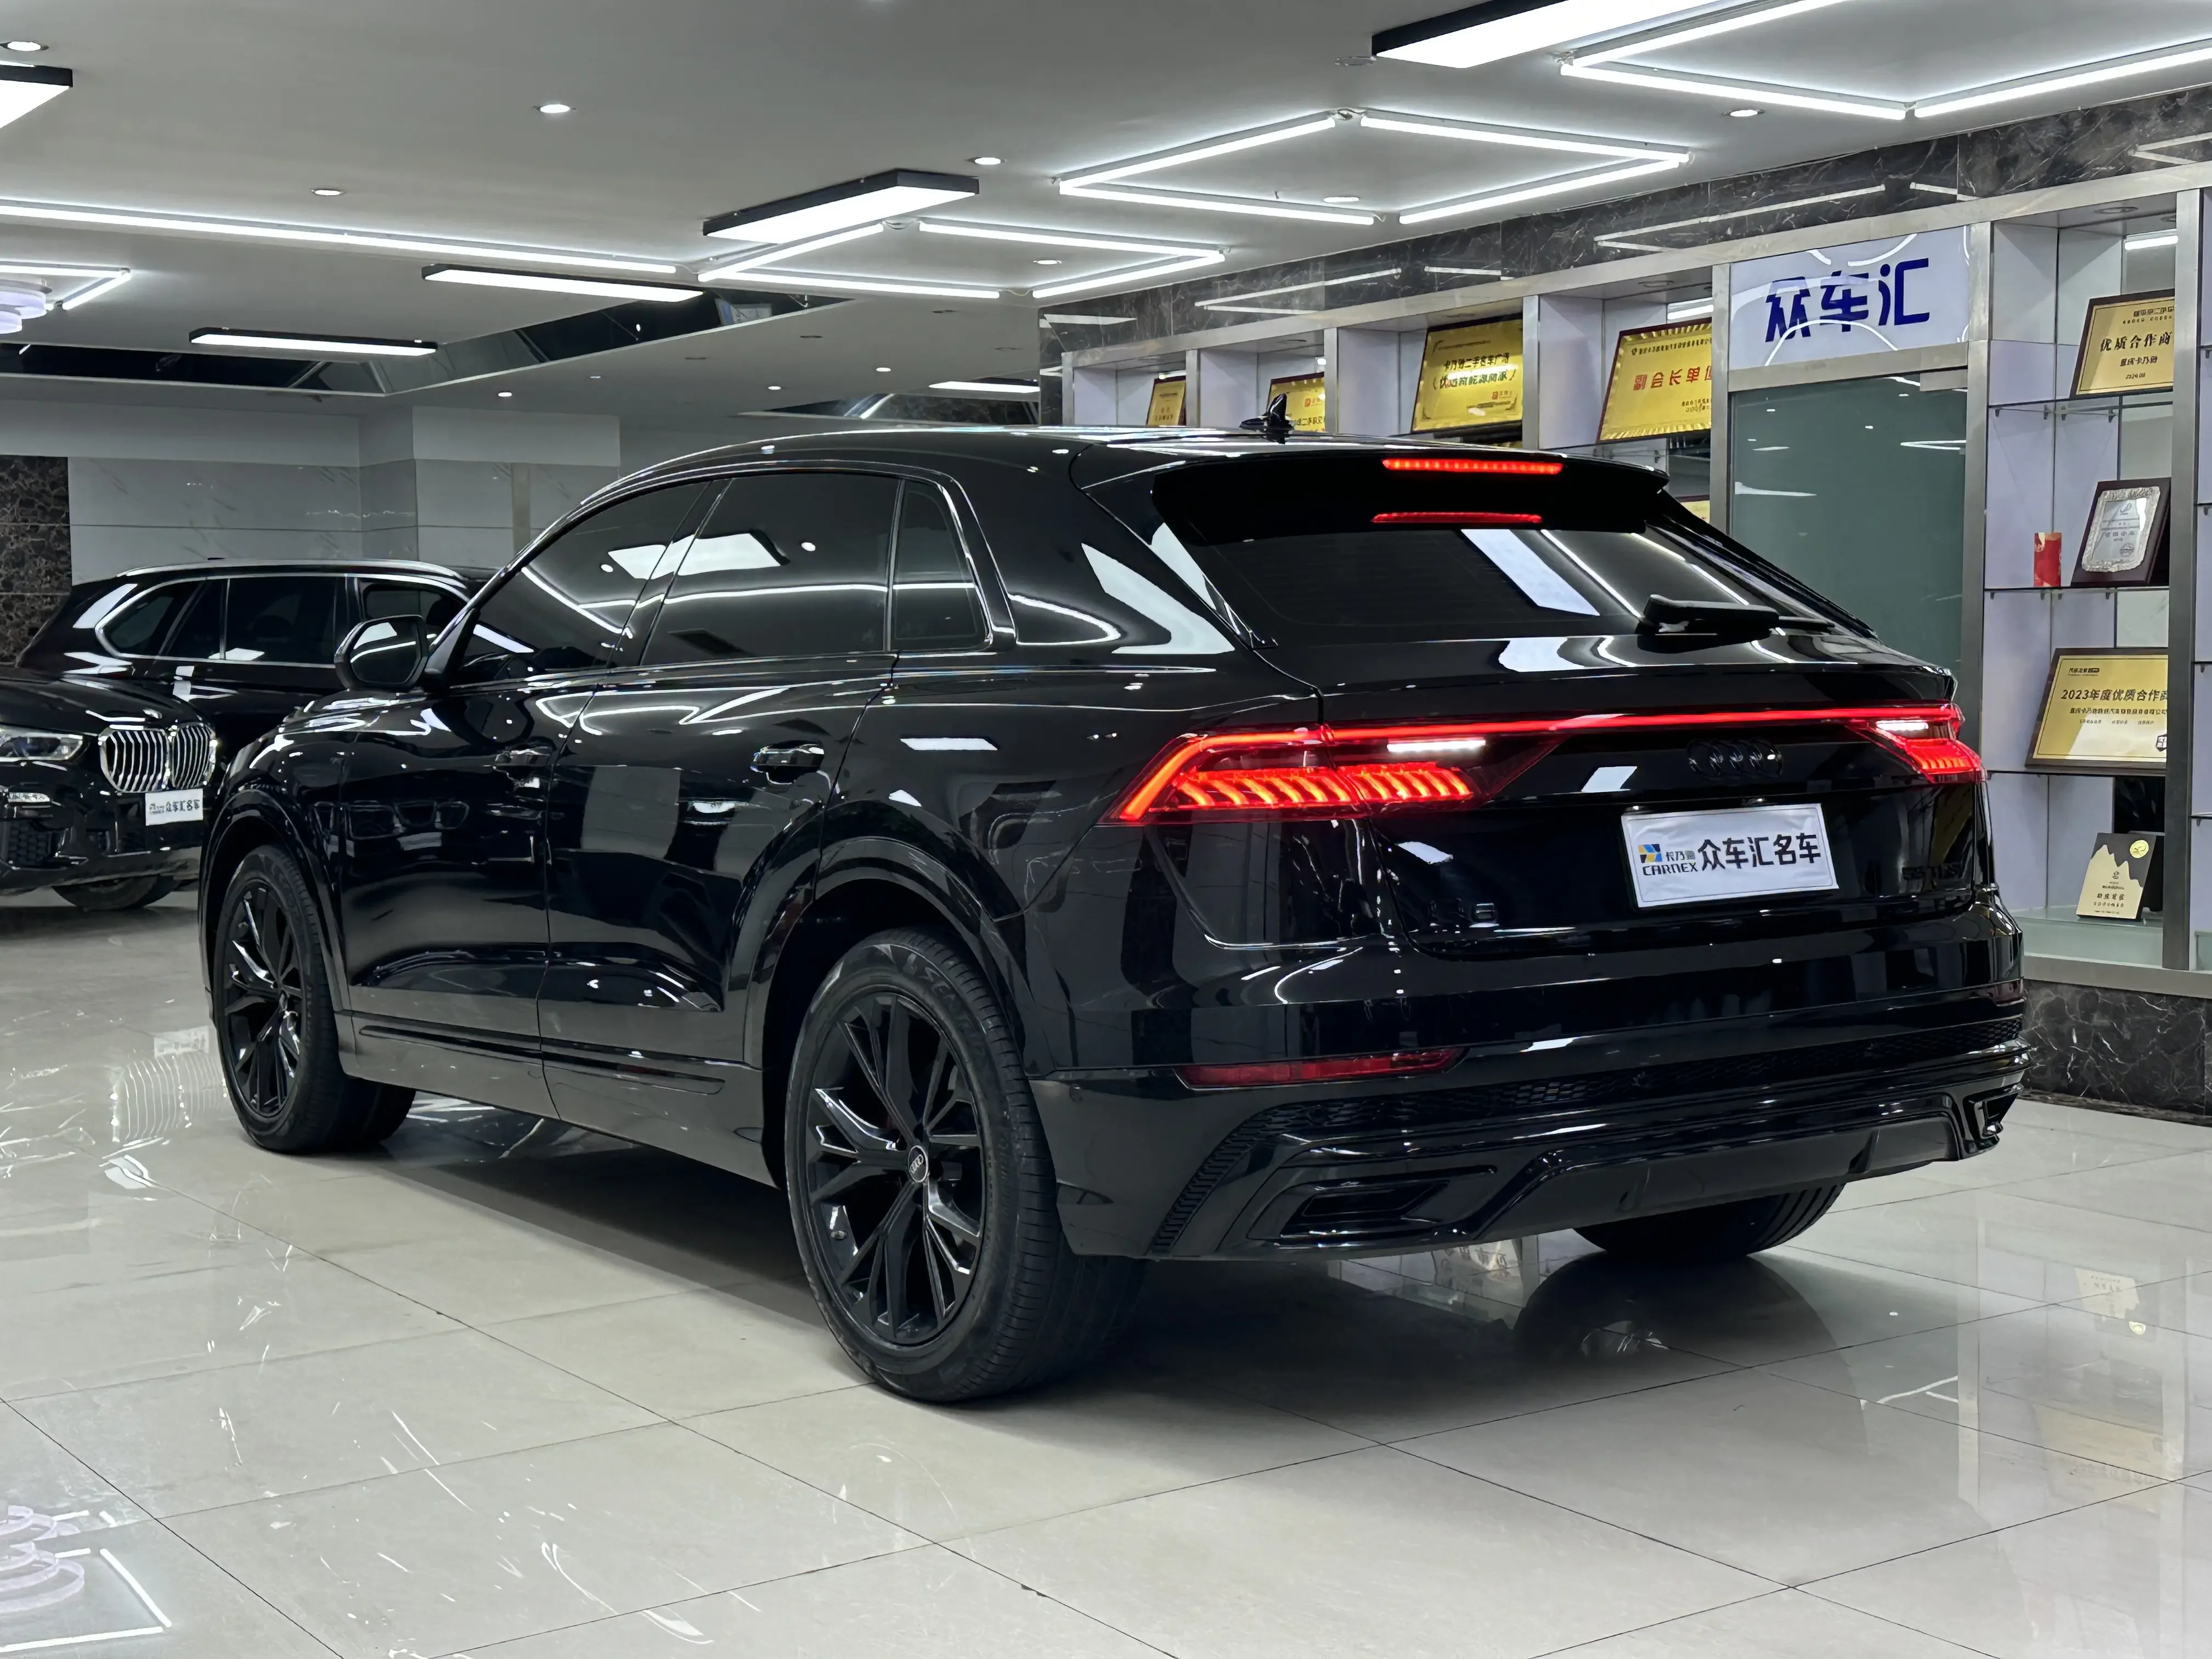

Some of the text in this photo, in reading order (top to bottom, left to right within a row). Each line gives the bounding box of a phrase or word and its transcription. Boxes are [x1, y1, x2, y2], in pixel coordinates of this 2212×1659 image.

[1764, 258, 1930, 343] 众车汇
[1642, 862, 1699, 876] CARNEX
[1697, 832, 1821, 871] 众车汇名车
